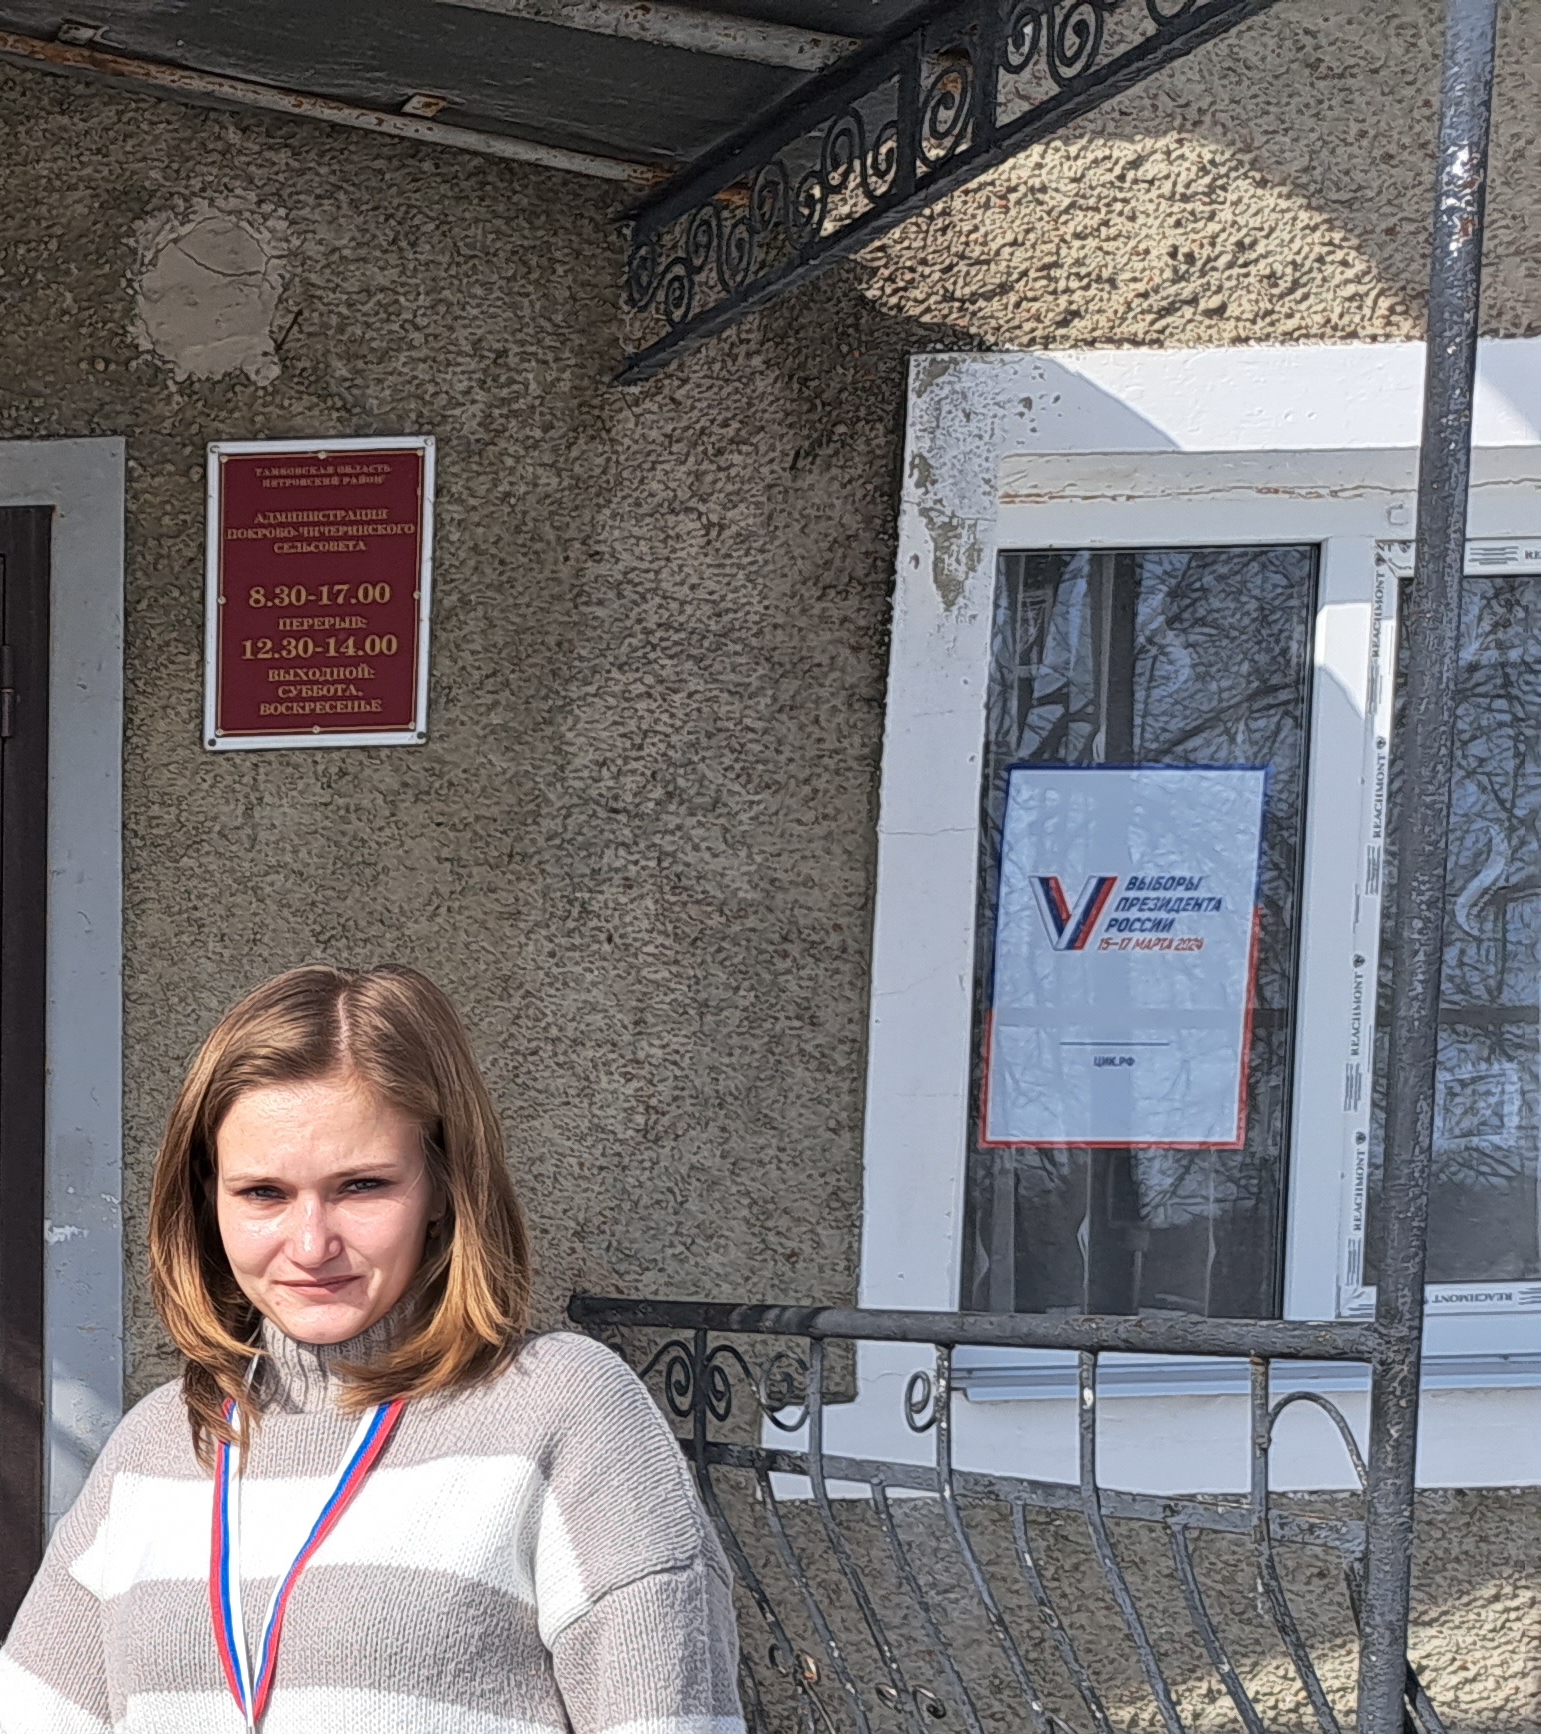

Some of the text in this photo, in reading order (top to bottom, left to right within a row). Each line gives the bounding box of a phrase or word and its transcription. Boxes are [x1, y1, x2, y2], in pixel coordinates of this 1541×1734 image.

[254, 508, 389, 524] АДМИНИСТРАЦИЯ
[273, 540, 366, 554] СЕЛЬСОВЕТА
[248, 582, 391, 608] 8.30-17.00
[278, 615, 368, 631] ПЕРЕРЫВ:
[241, 634, 398, 660] 12.30-14.00
[267, 663, 376, 682] ВЫХОДНОЙ:
[259, 698, 383, 716] ВОСКРЕСЕНЬЕ
[1125, 876, 1204, 892] ВЫБОРЫ
[1114, 896, 1223, 914] ПРЕЗИДЕНТА
[1104, 917, 1176, 933] РОССИИ
[1133, 937, 1174, 951] МАРТА
[1174, 937, 1205, 951] 2024
